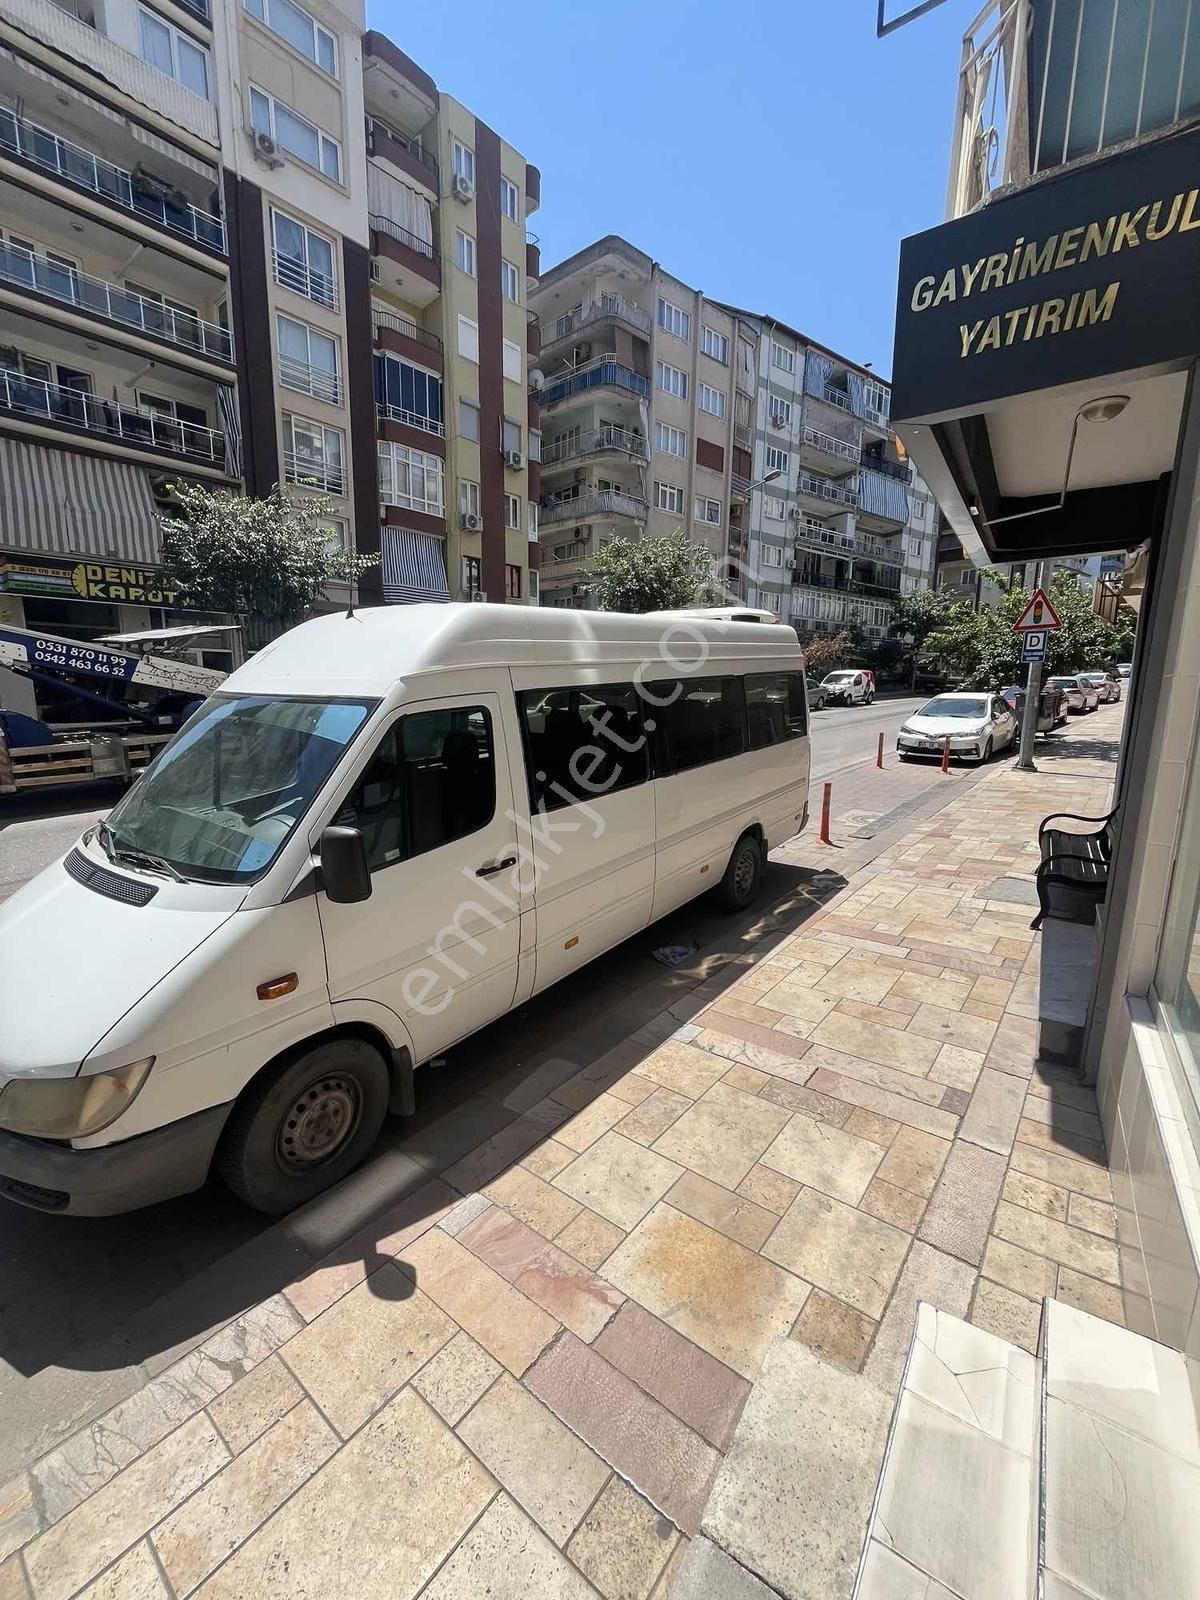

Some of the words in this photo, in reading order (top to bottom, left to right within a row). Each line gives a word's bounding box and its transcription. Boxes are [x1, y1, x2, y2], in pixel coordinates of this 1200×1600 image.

[910, 189, 1200, 312] GAYRİMENKUL
[960, 281, 1120, 358] YATIRIM
[36, 640, 67, 654] 0531
[70, 647, 95, 659] 870
[98, 653, 107, 663] 11
[110, 656, 127, 666] 99
[1030, 635, 1040, 647] D
[35, 651, 66, 665] 0542
[68, 659, 92, 670] 463
[94, 663, 110, 673] 66
[112, 667, 125, 676] 52
